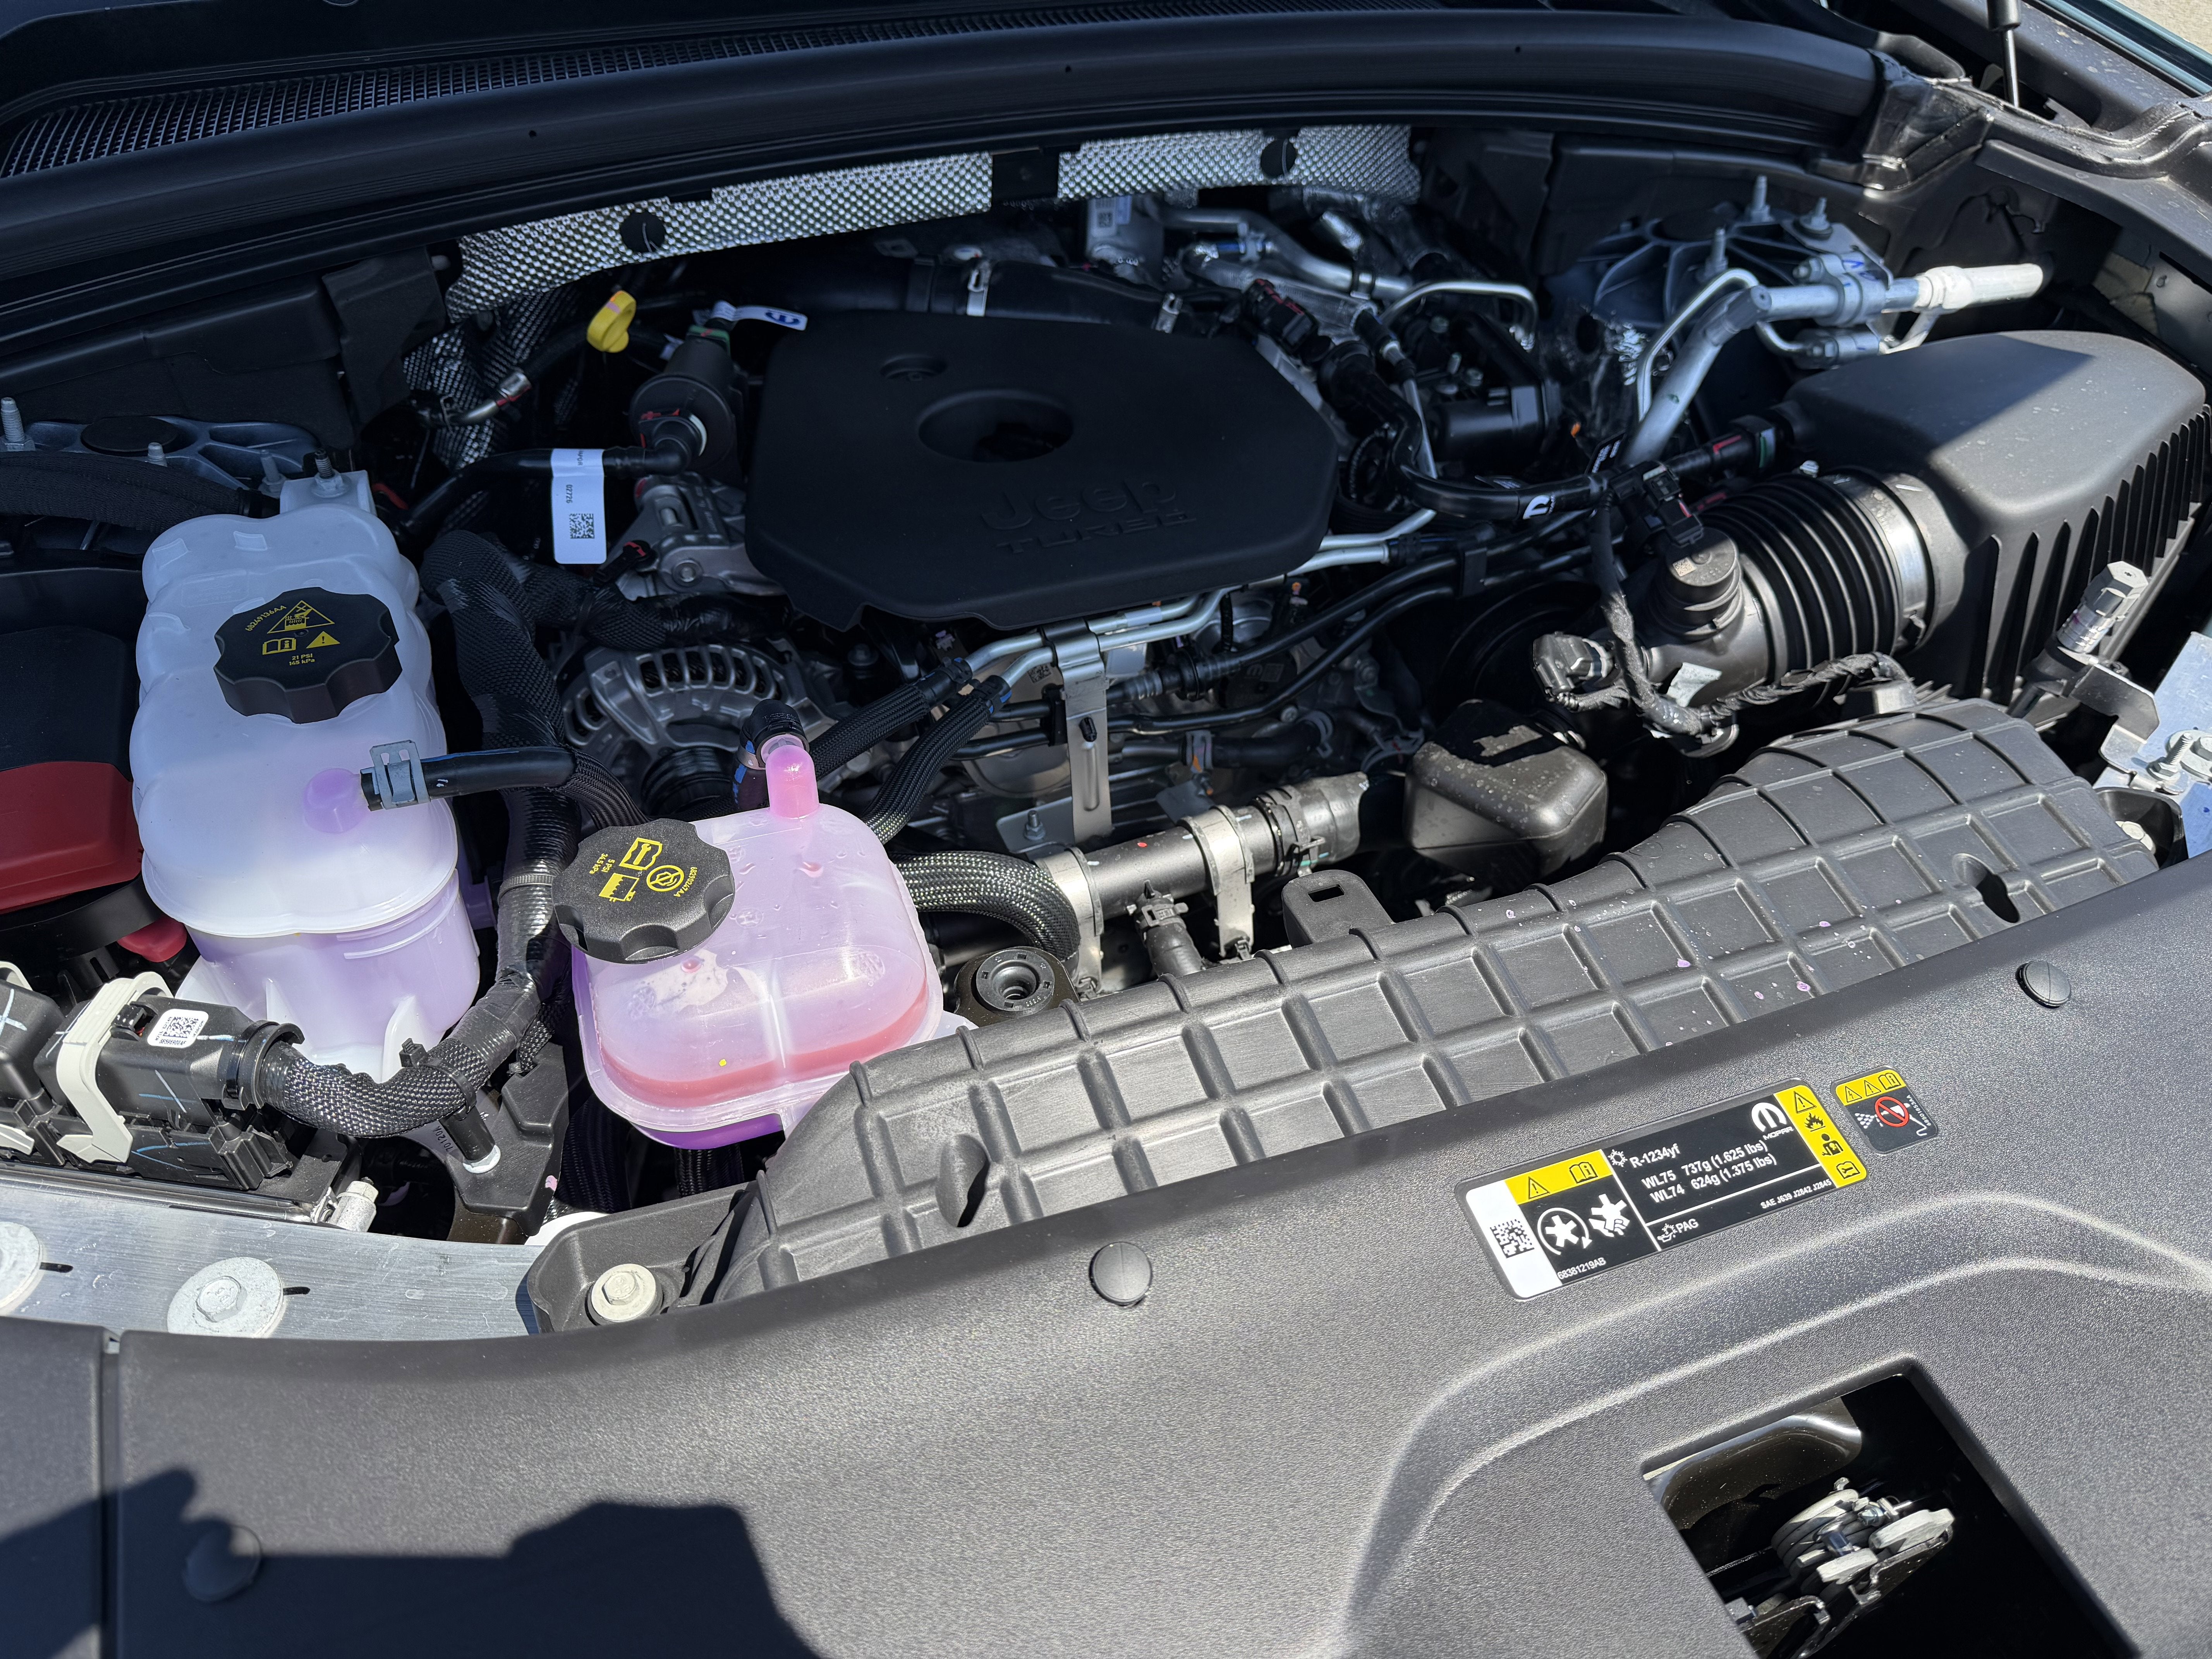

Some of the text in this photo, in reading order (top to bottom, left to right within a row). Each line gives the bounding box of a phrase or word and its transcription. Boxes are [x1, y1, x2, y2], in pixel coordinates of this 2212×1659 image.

[980, 479, 1176, 531] Jeep
[589, 864, 601, 874] kPa
[601, 863, 612, 872] PSI
[1906, 1094, 1931, 1126] 68501853AA
[1763, 1126, 1794, 1140] MOPAR
[1629, 1143, 1681, 1168] R-1234yf
[1641, 1140, 1768, 1188] WL75 737g (1.625 lbs)
[1650, 1153, 1778, 1203] WL74 624g (1.375 lbs)
[1760, 1200, 1776, 1209] SAE
[1777, 1193, 1793, 1204] J639
[1793, 1185, 1812, 1198] J2842
[1676, 1218, 1699, 1233] PAG
[1557, 1257, 1607, 1279] 68381219AB
